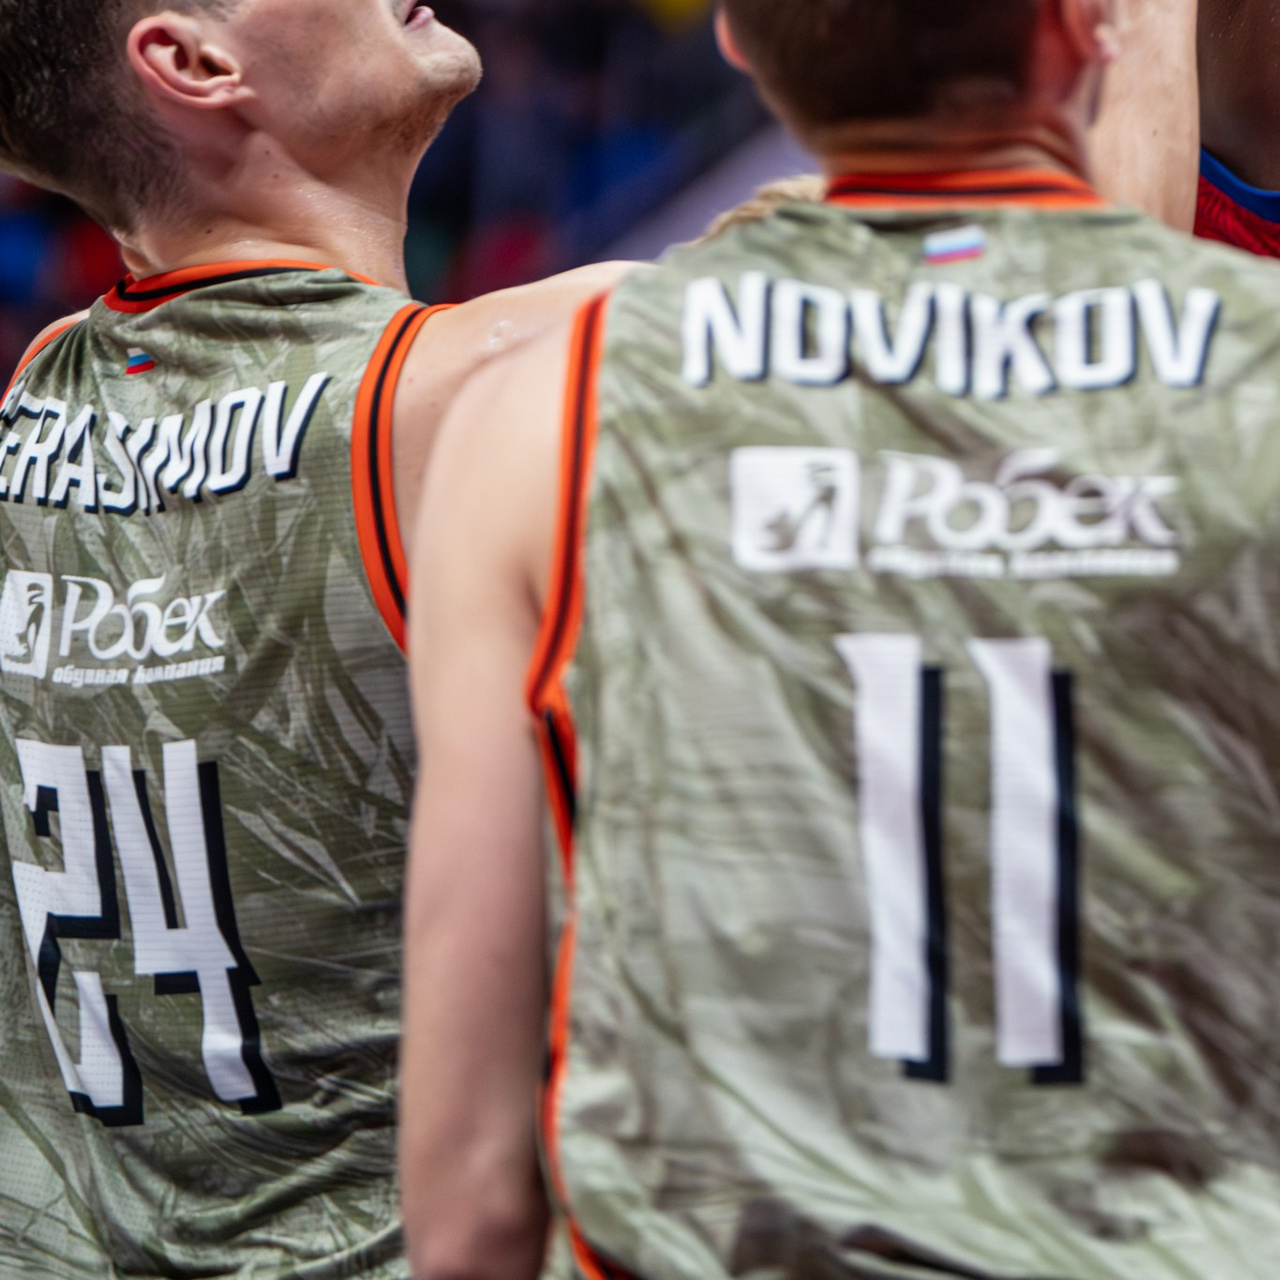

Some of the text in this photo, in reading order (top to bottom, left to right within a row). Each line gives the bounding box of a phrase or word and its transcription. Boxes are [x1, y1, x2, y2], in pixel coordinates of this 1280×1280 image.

[682, 271, 1220, 400] NOVIKOV
[0, 372, 332, 515] ERASIMOV
[877, 448, 1178, 552] Робек
[59, 572, 227, 660] Робек
[833, 634, 1082, 1083] 11
[12, 739, 280, 1126] 24
